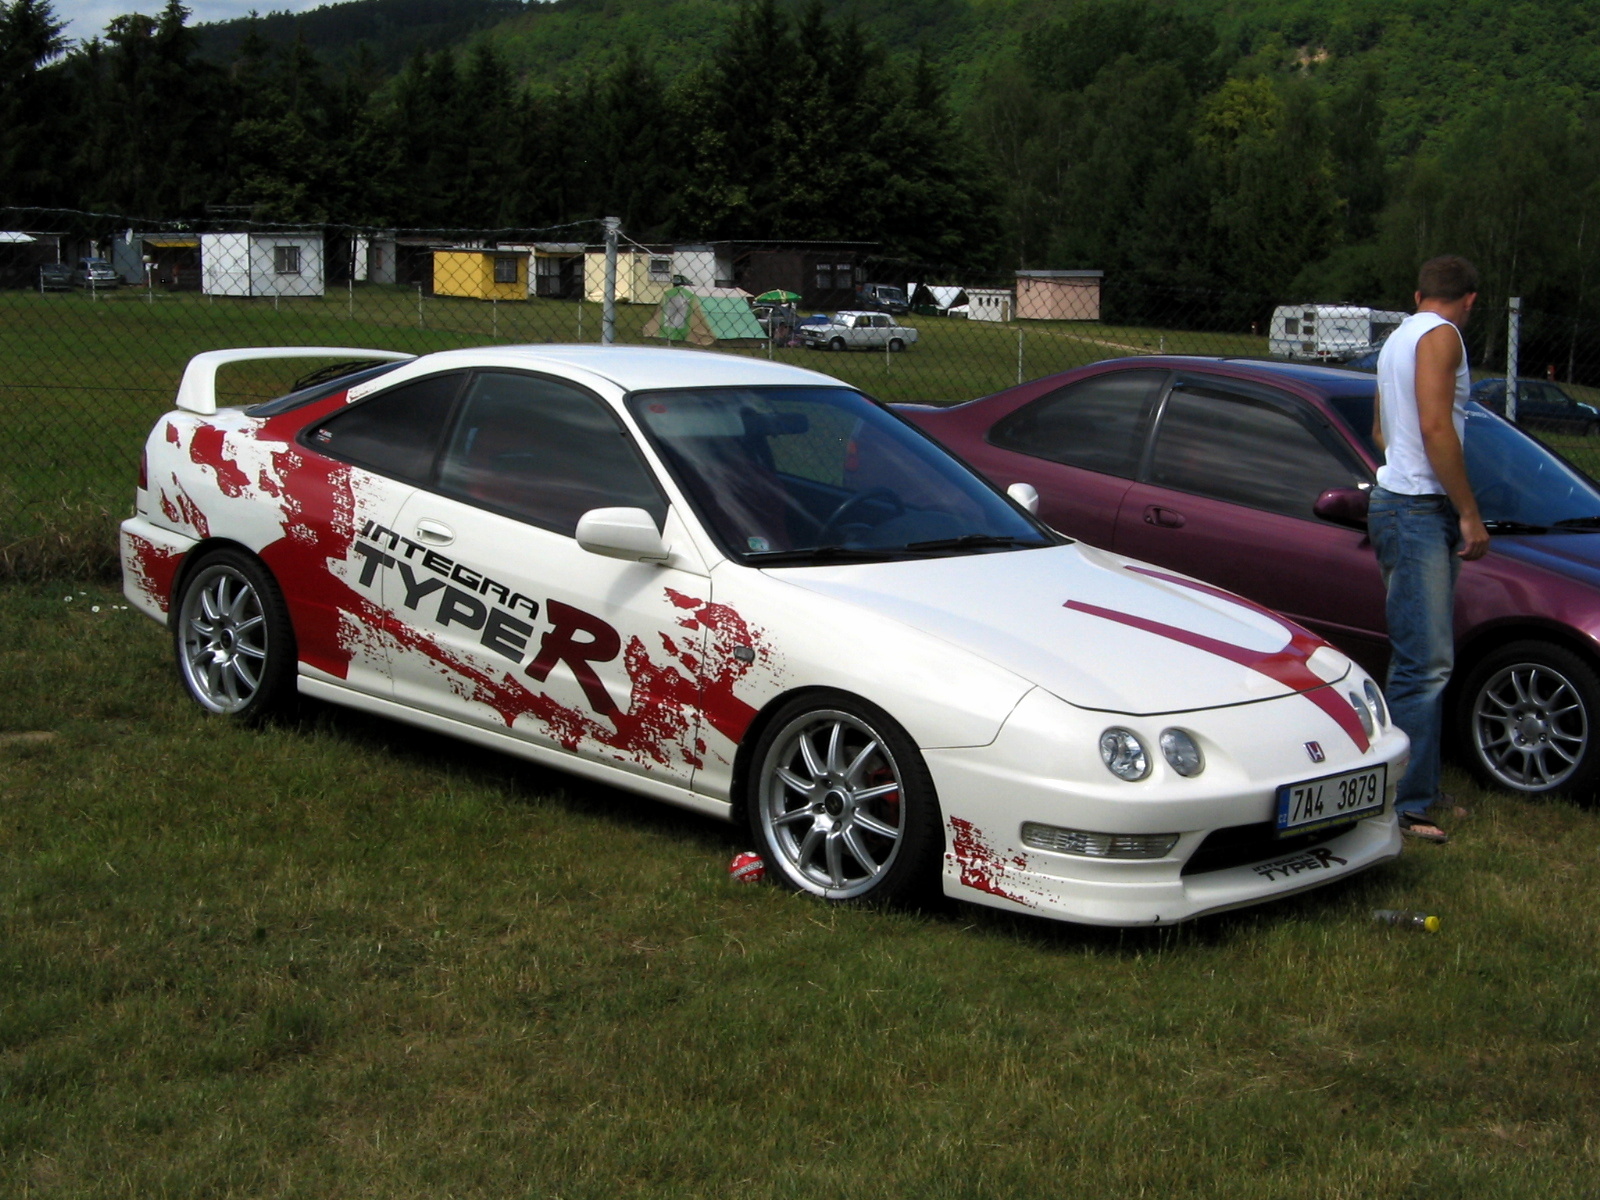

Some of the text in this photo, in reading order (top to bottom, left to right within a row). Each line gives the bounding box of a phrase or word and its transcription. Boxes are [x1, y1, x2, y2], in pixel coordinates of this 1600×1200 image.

[362, 520, 540, 620] INTEGRA
[1293, 773, 1377, 821] 7A4 3879
